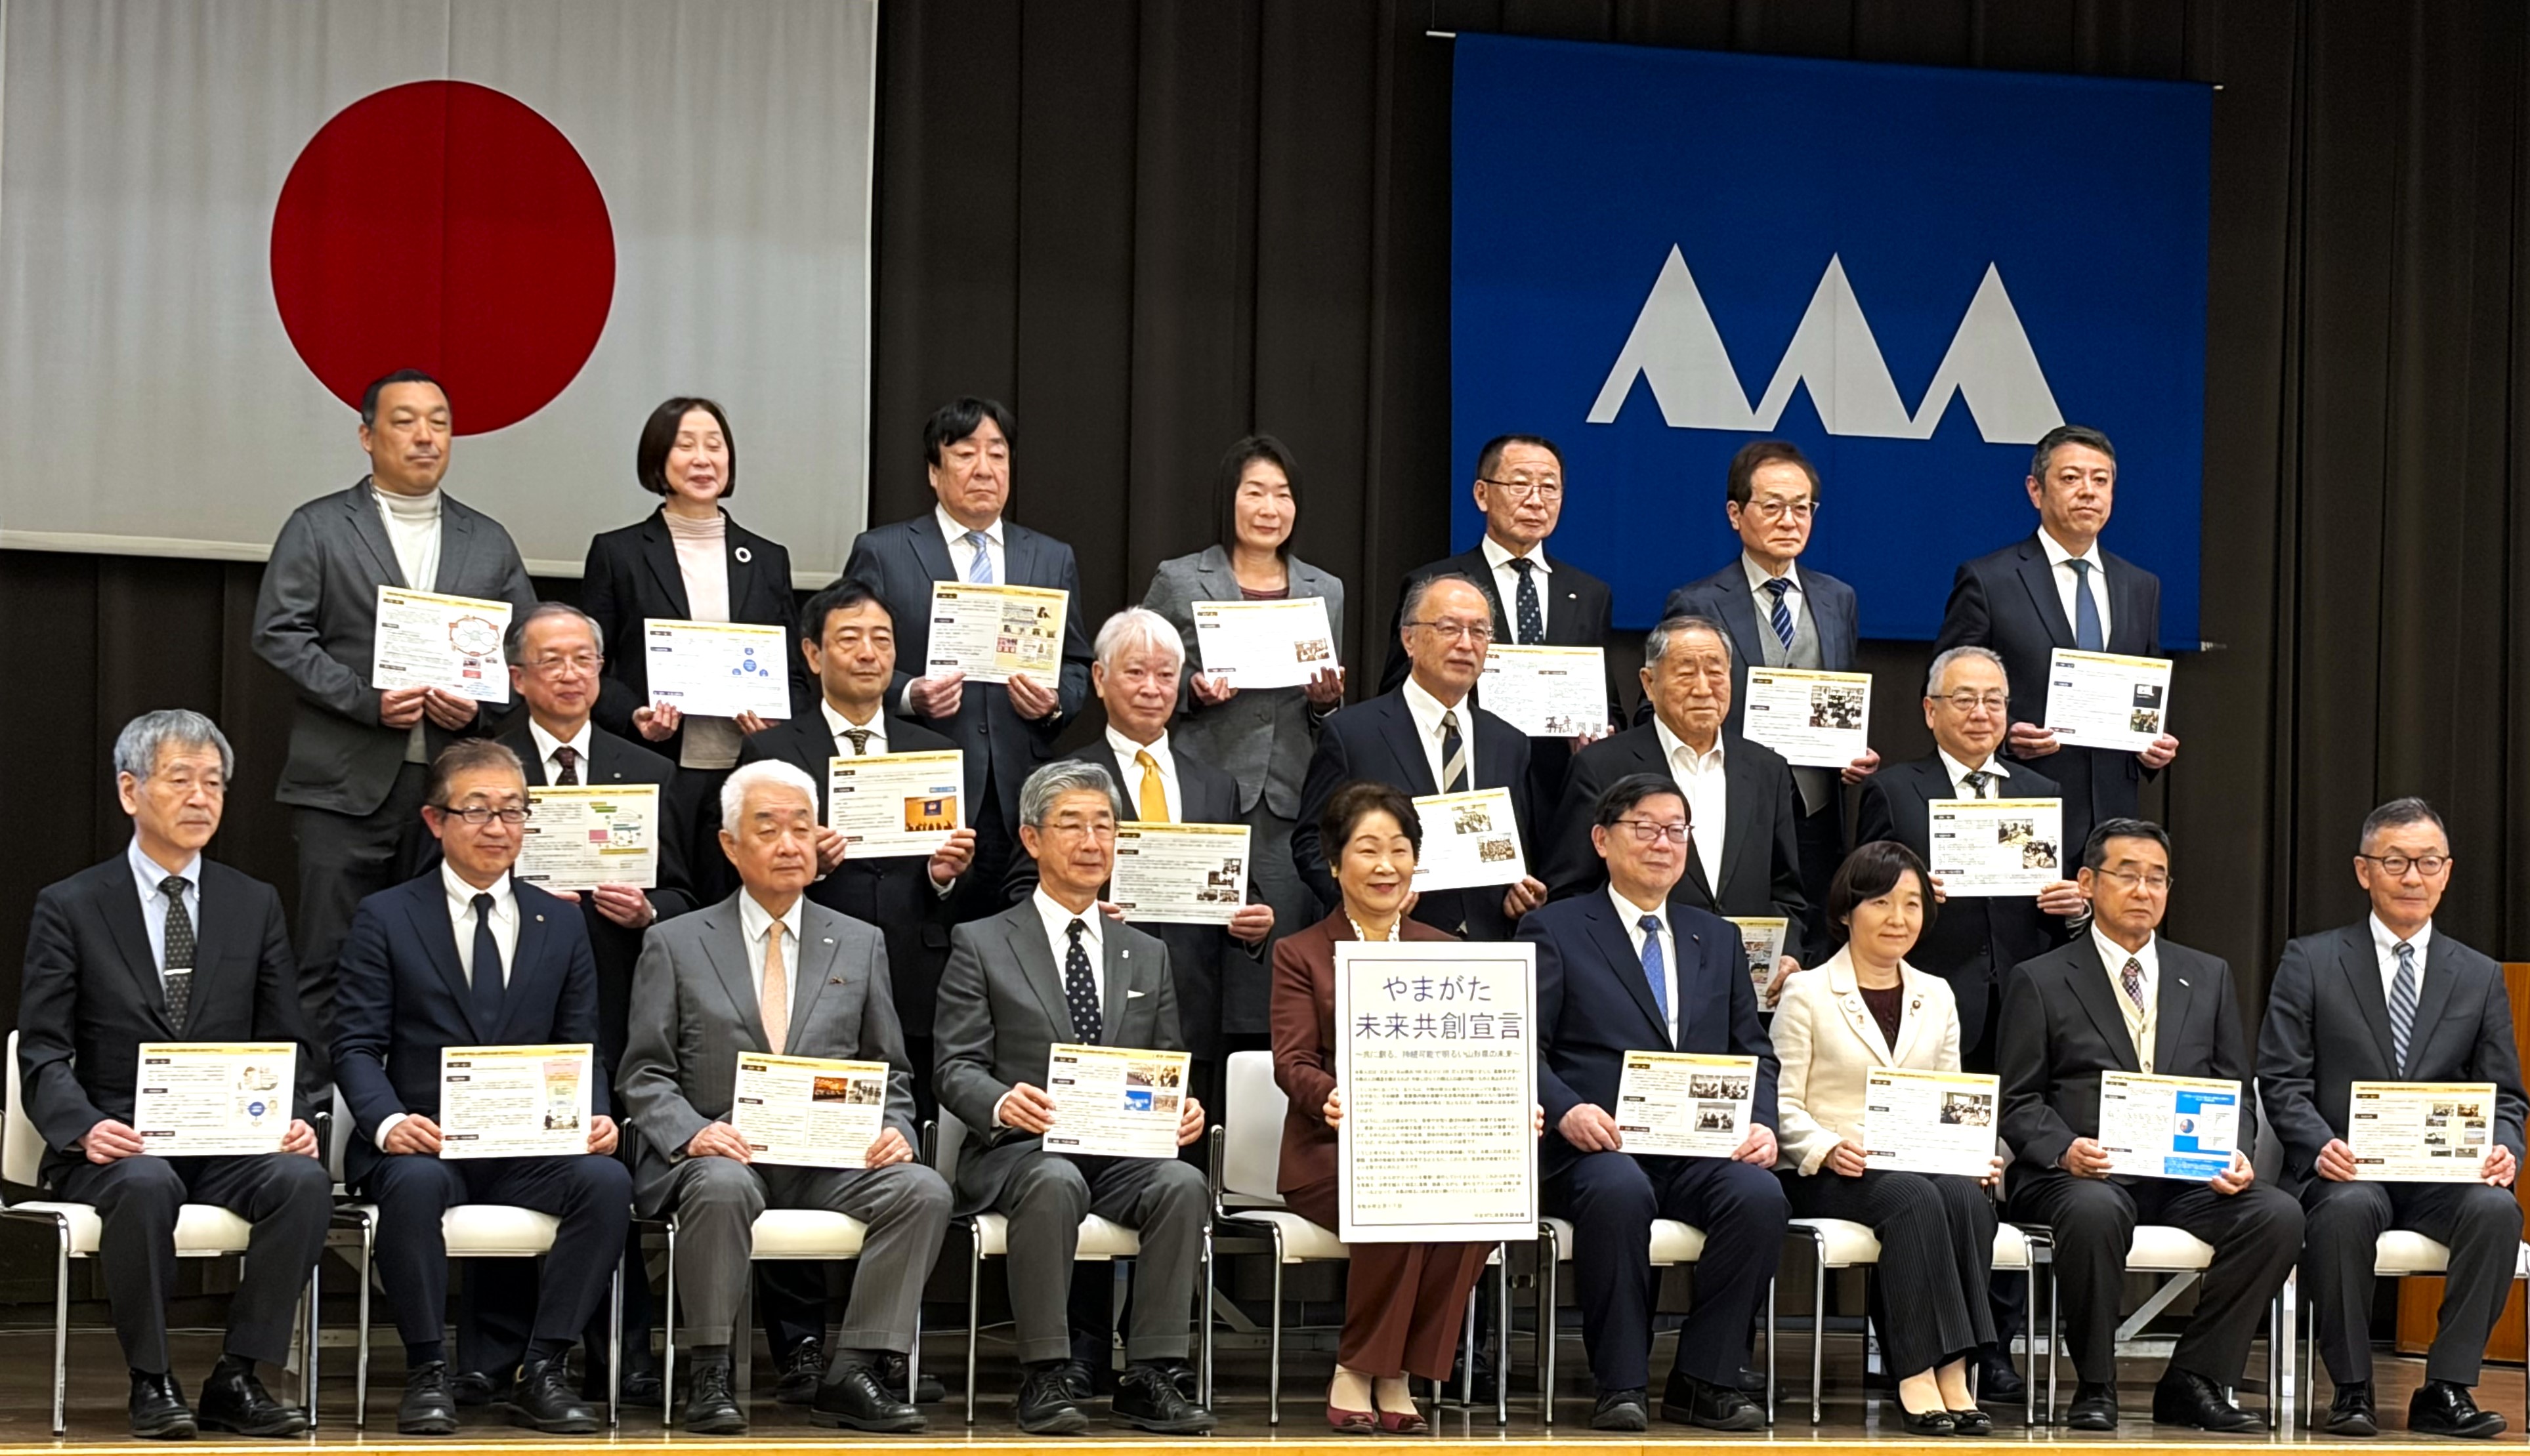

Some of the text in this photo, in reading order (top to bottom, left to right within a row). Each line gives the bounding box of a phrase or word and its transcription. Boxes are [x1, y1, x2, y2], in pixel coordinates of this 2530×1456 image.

[1383, 975, 1490, 1001] やまがた
[1356, 1012, 1522, 1039] 未来共創宣言
